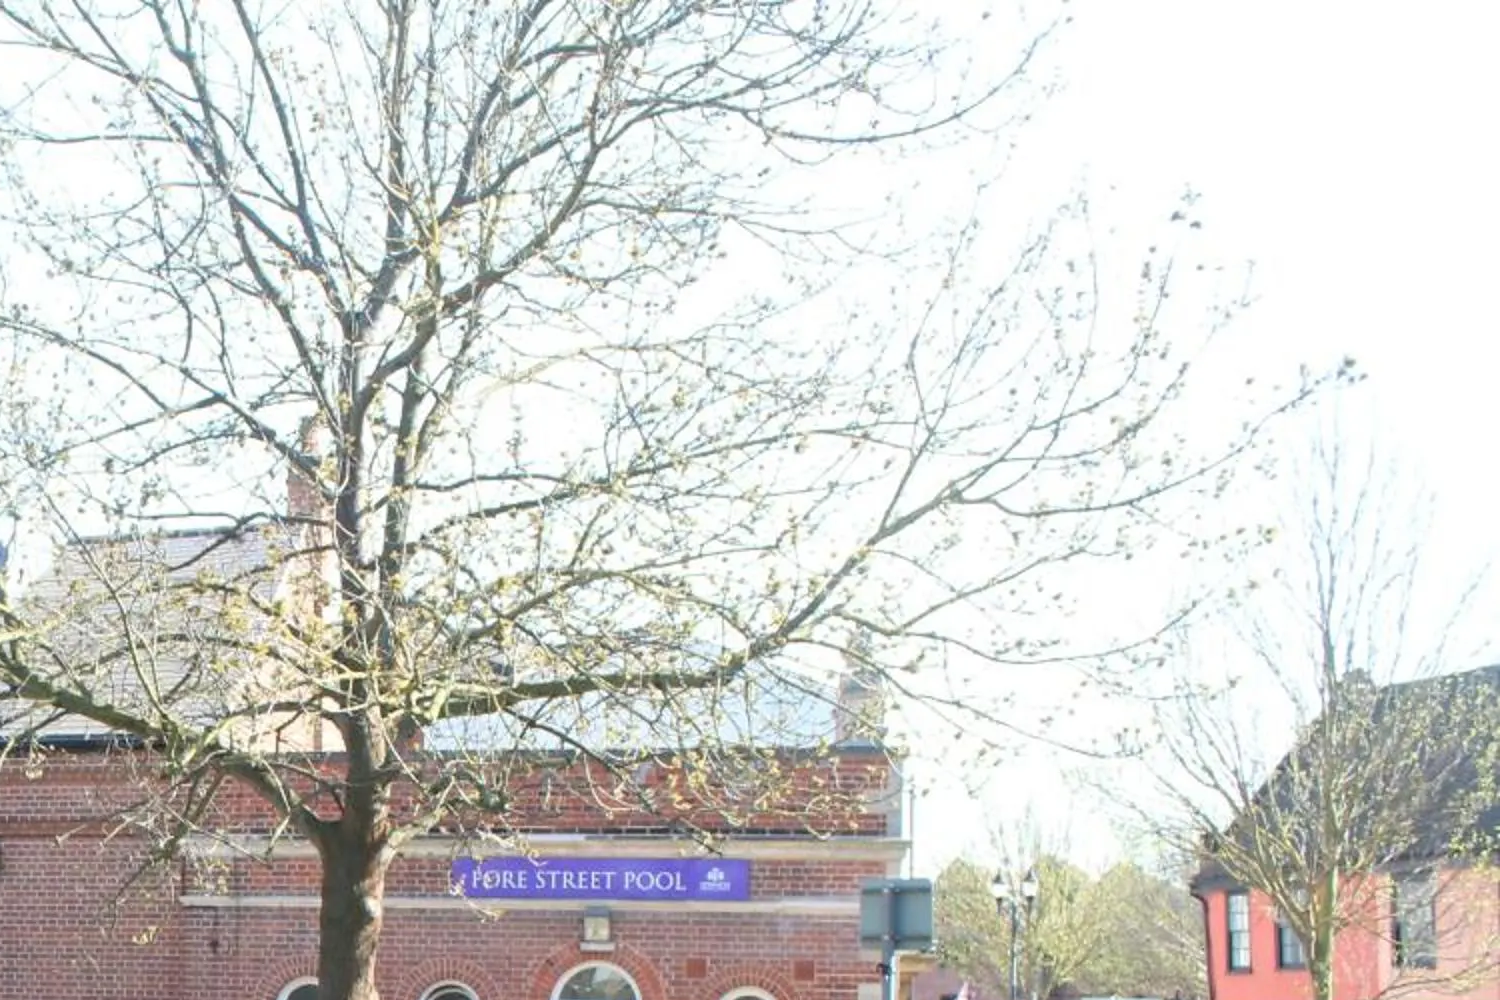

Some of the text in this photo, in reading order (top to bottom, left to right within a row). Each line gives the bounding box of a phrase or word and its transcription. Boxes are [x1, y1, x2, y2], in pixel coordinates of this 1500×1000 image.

[472, 870, 528, 889] FORE
[535, 870, 617, 889] STREET
[624, 870, 687, 891] POOL
